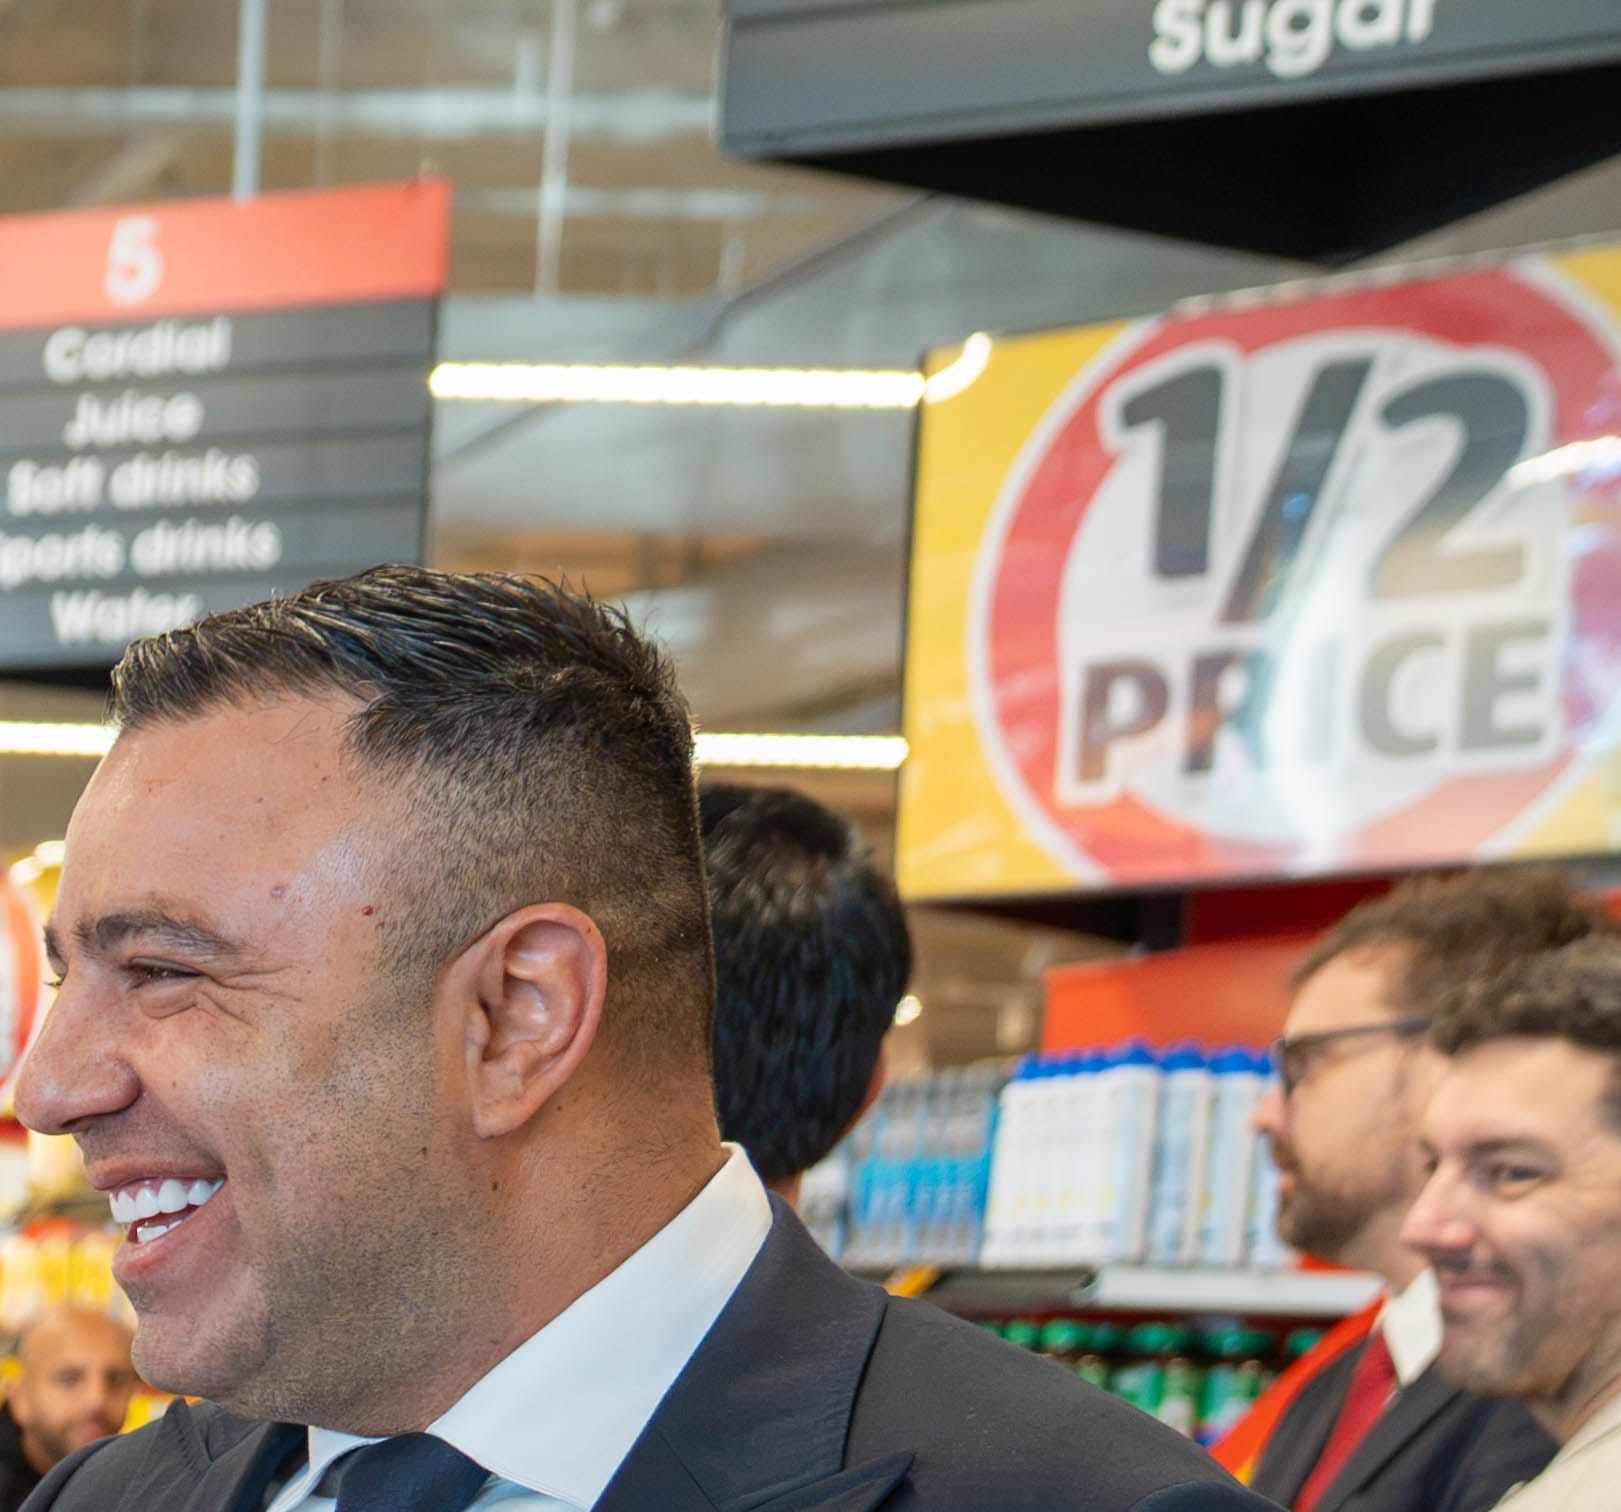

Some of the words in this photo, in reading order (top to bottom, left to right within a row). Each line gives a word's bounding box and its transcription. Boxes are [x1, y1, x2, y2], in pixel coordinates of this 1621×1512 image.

[103, 216, 164, 305] 5
[44, 316, 232, 384] Cordial
[63, 392, 203, 450] Juice
[7, 458, 103, 518] Soft
[109, 448, 260, 511] drinks
[1118, 355, 1532, 628] 1/2
[130, 515, 283, 578] drinks
[49, 586, 202, 646] Water
[1074, 618, 1552, 784] PRICE
